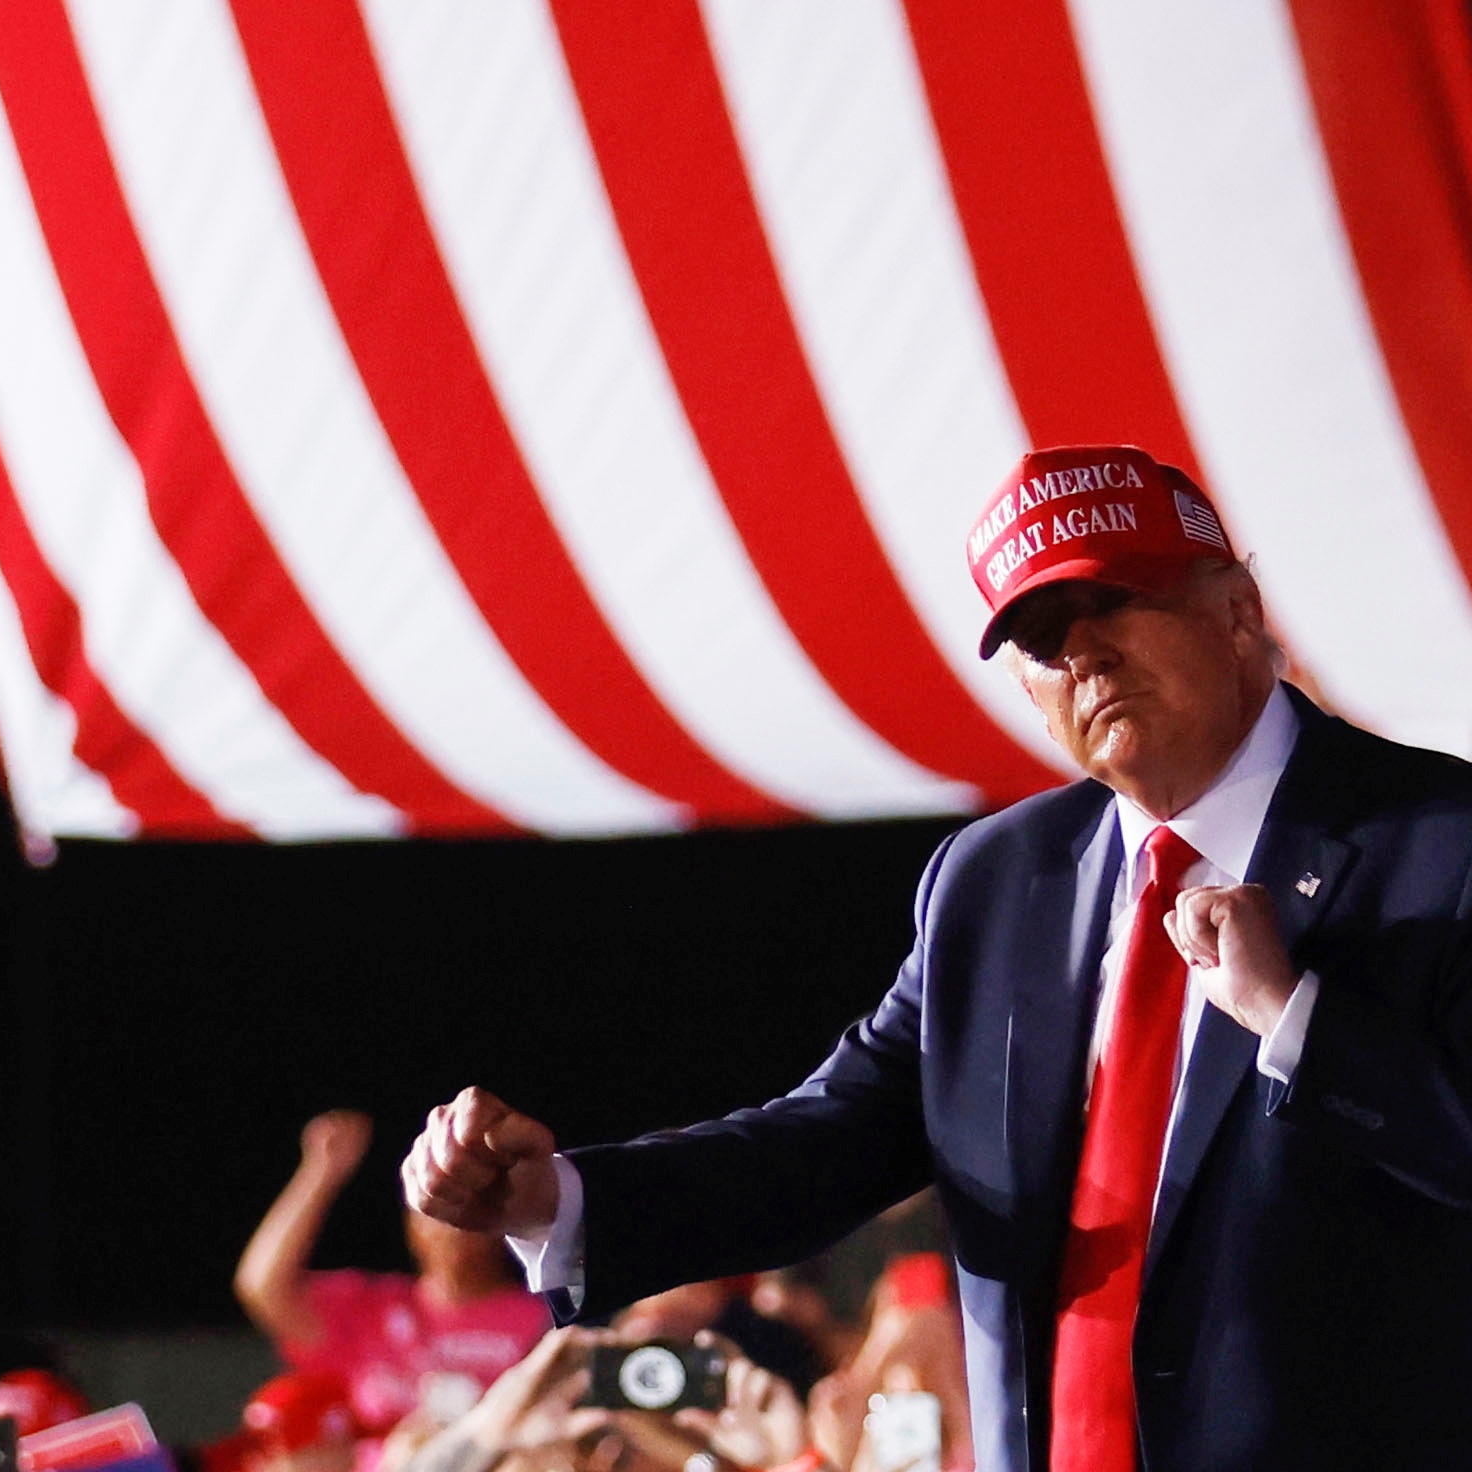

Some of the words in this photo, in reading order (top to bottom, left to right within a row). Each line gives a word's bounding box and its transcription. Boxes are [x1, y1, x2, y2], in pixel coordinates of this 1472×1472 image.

[970, 493, 1017, 566] MAKE
[1019, 463, 1144, 515] AMERICA
[986, 521, 1046, 593] GREAT
[1053, 503, 1137, 545] AGAIN
